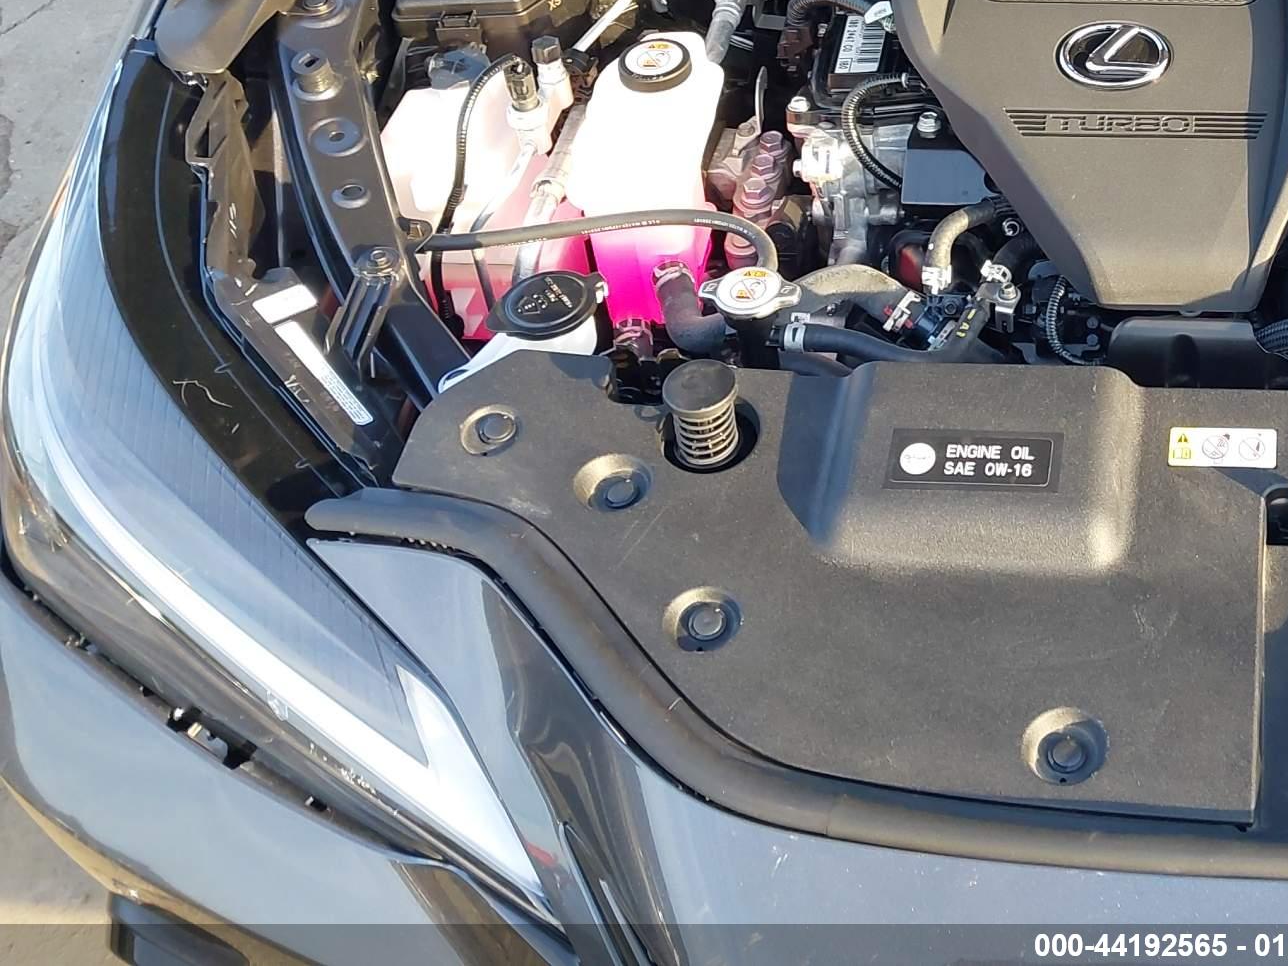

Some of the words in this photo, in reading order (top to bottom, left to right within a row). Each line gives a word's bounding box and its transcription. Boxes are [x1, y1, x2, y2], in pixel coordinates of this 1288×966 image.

[1050, 115, 1190, 133] TURBO
[945, 444, 1002, 459] ENGINE
[1010, 445, 1035, 461] OIL
[943, 461, 976, 476] SAE
[984, 462, 1033, 477] 0W-16
